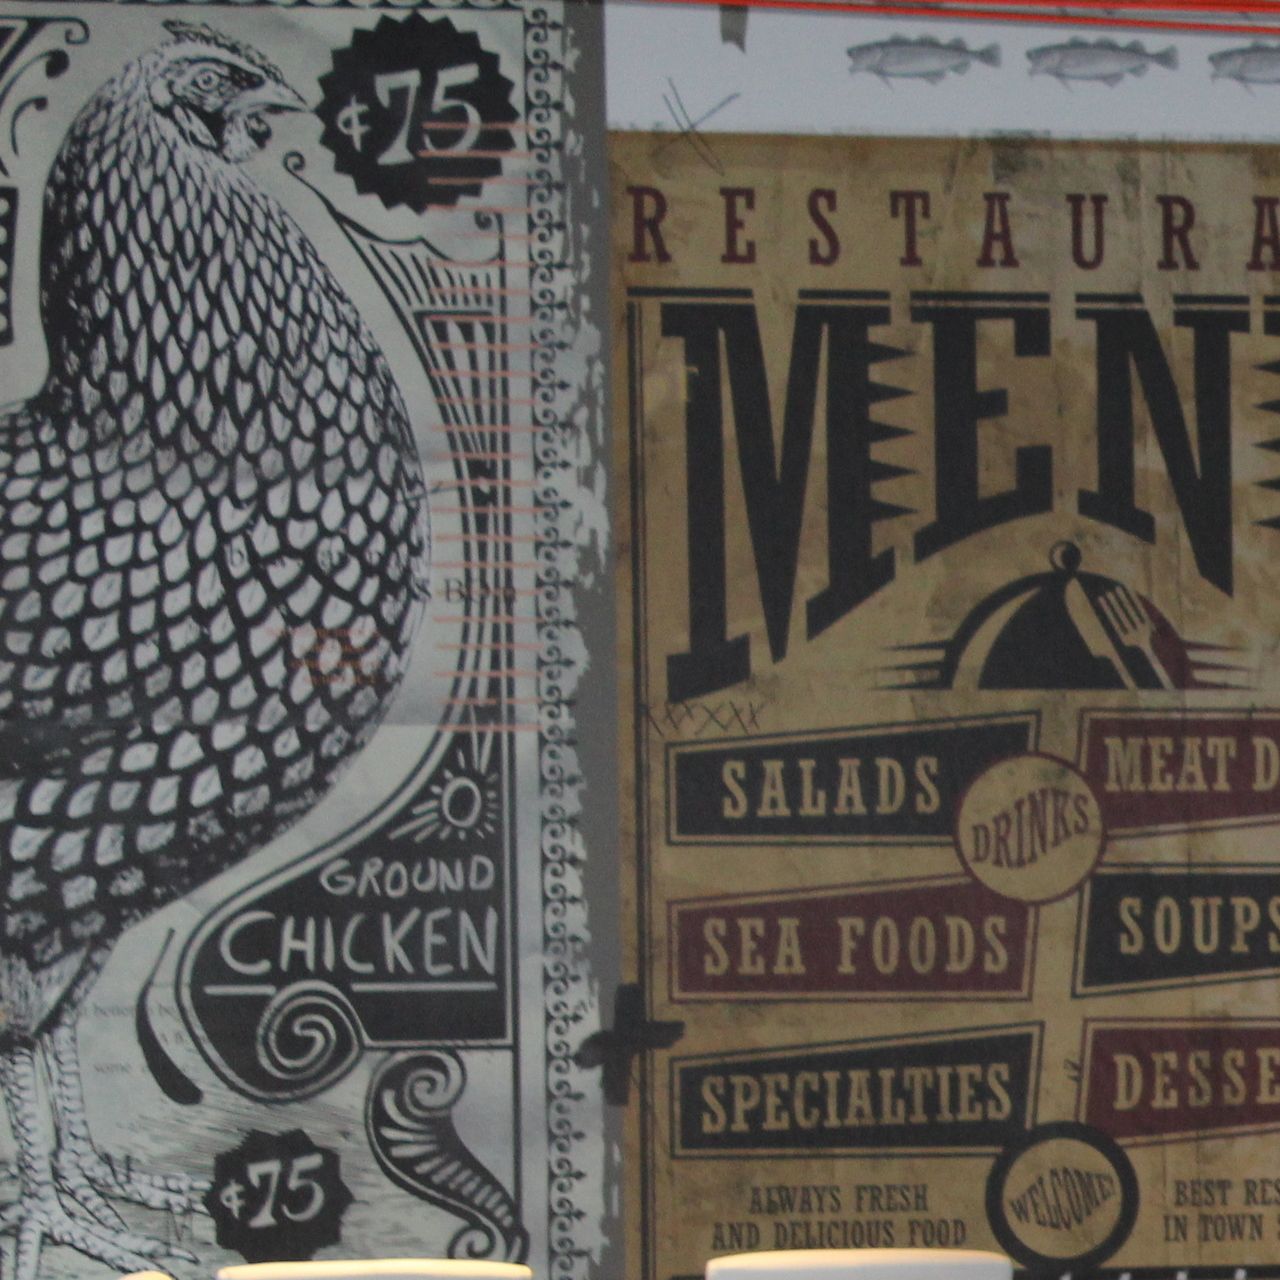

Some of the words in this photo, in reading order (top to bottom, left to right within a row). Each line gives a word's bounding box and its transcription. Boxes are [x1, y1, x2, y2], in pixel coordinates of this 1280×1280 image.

[721, 754, 942, 820] SALADS
[1103, 736, 1236, 794] MEAT
[971, 786, 1092, 869] DRINKS
[319, 856, 496, 897] GROUND
[219, 907, 499, 977] CHICKEN
[703, 917, 805, 977] SEA
[838, 916, 1009, 976] FOODS
[700, 1062, 1012, 1133] SPECIALTIES
[748, 1186, 844, 1217] ALWAYS
[854, 1183, 929, 1214] FRESH
[1174, 1177, 1237, 1208] BEST
[712, 1222, 766, 1252] AND
[772, 1220, 902, 1251] DELICIOUS
[906, 1219, 968, 1249] FOOD
[1164, 1214, 1190, 1243] IN
[1199, 1213, 1268, 1242] TOWN
